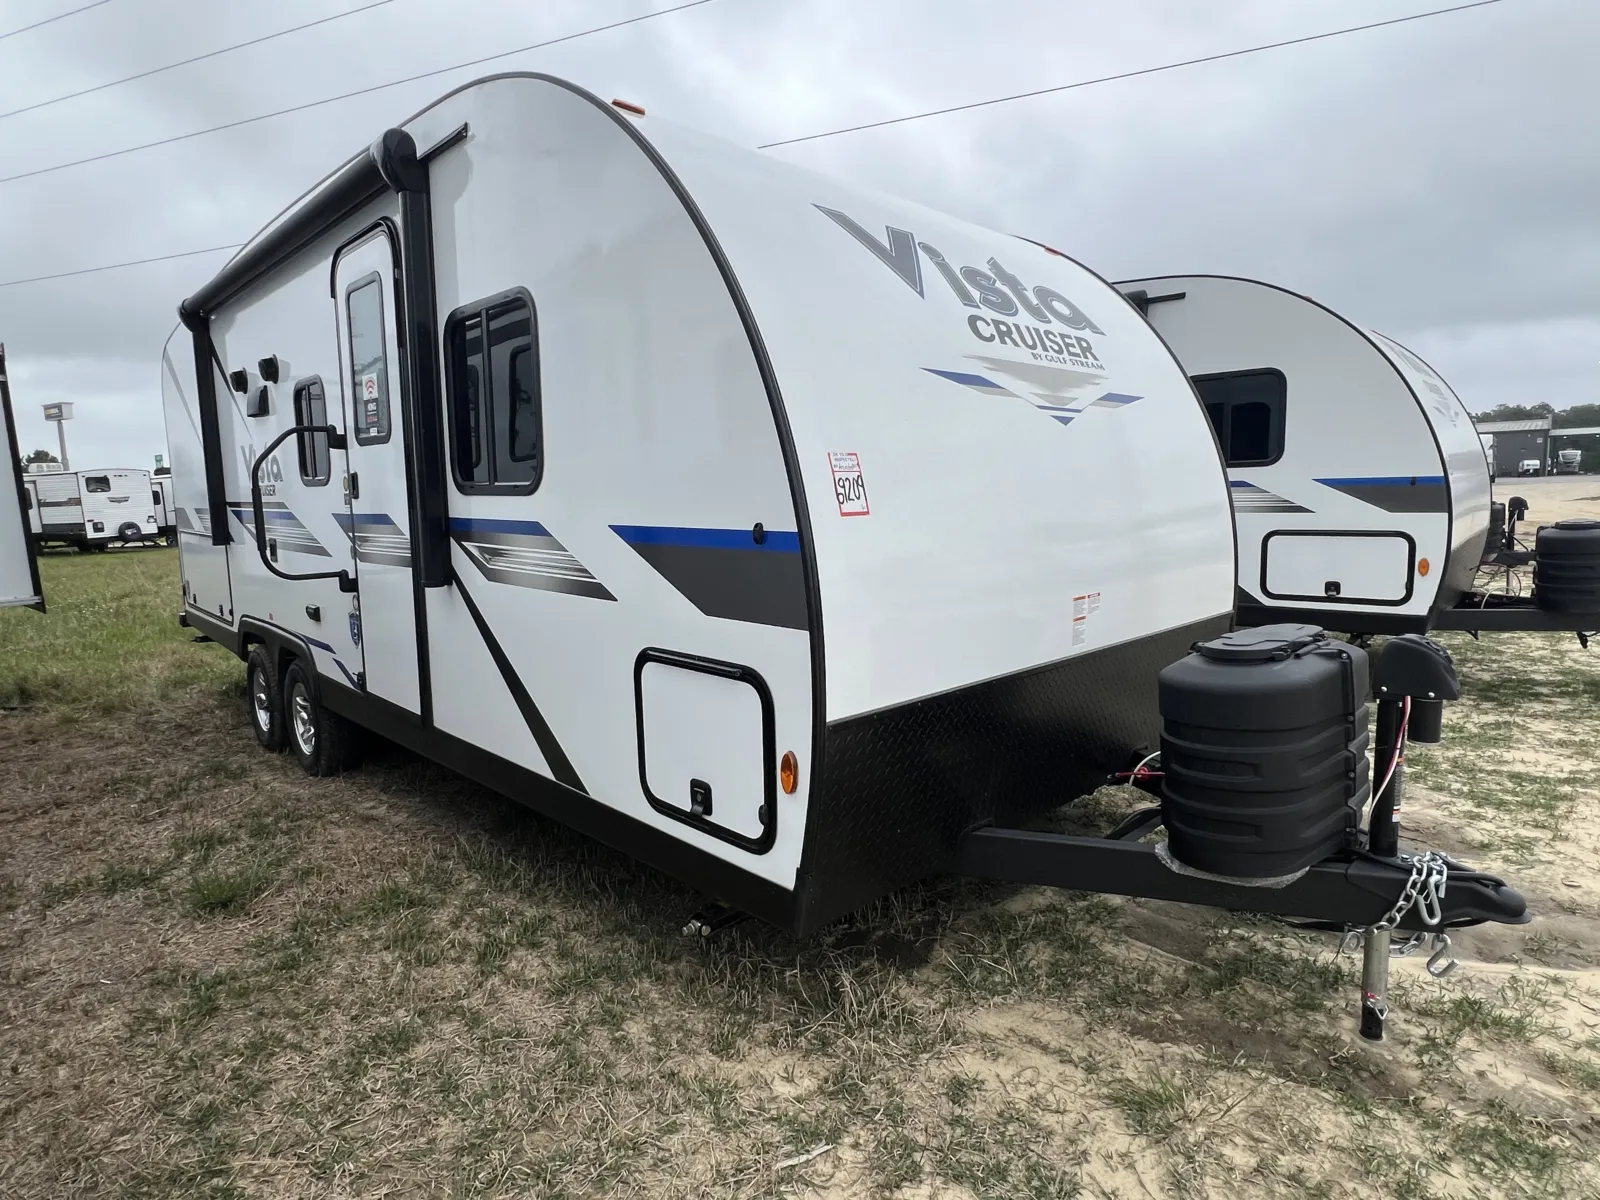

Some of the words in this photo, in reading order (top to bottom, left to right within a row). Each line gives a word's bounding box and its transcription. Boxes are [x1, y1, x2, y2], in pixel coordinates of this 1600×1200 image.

[810, 202, 1107, 337] Vista
[967, 314, 1099, 361] CRUISER
[1031, 353, 1043, 361] BY
[1044, 355, 1067, 364] GULF
[1069, 359, 1105, 371] STREAM
